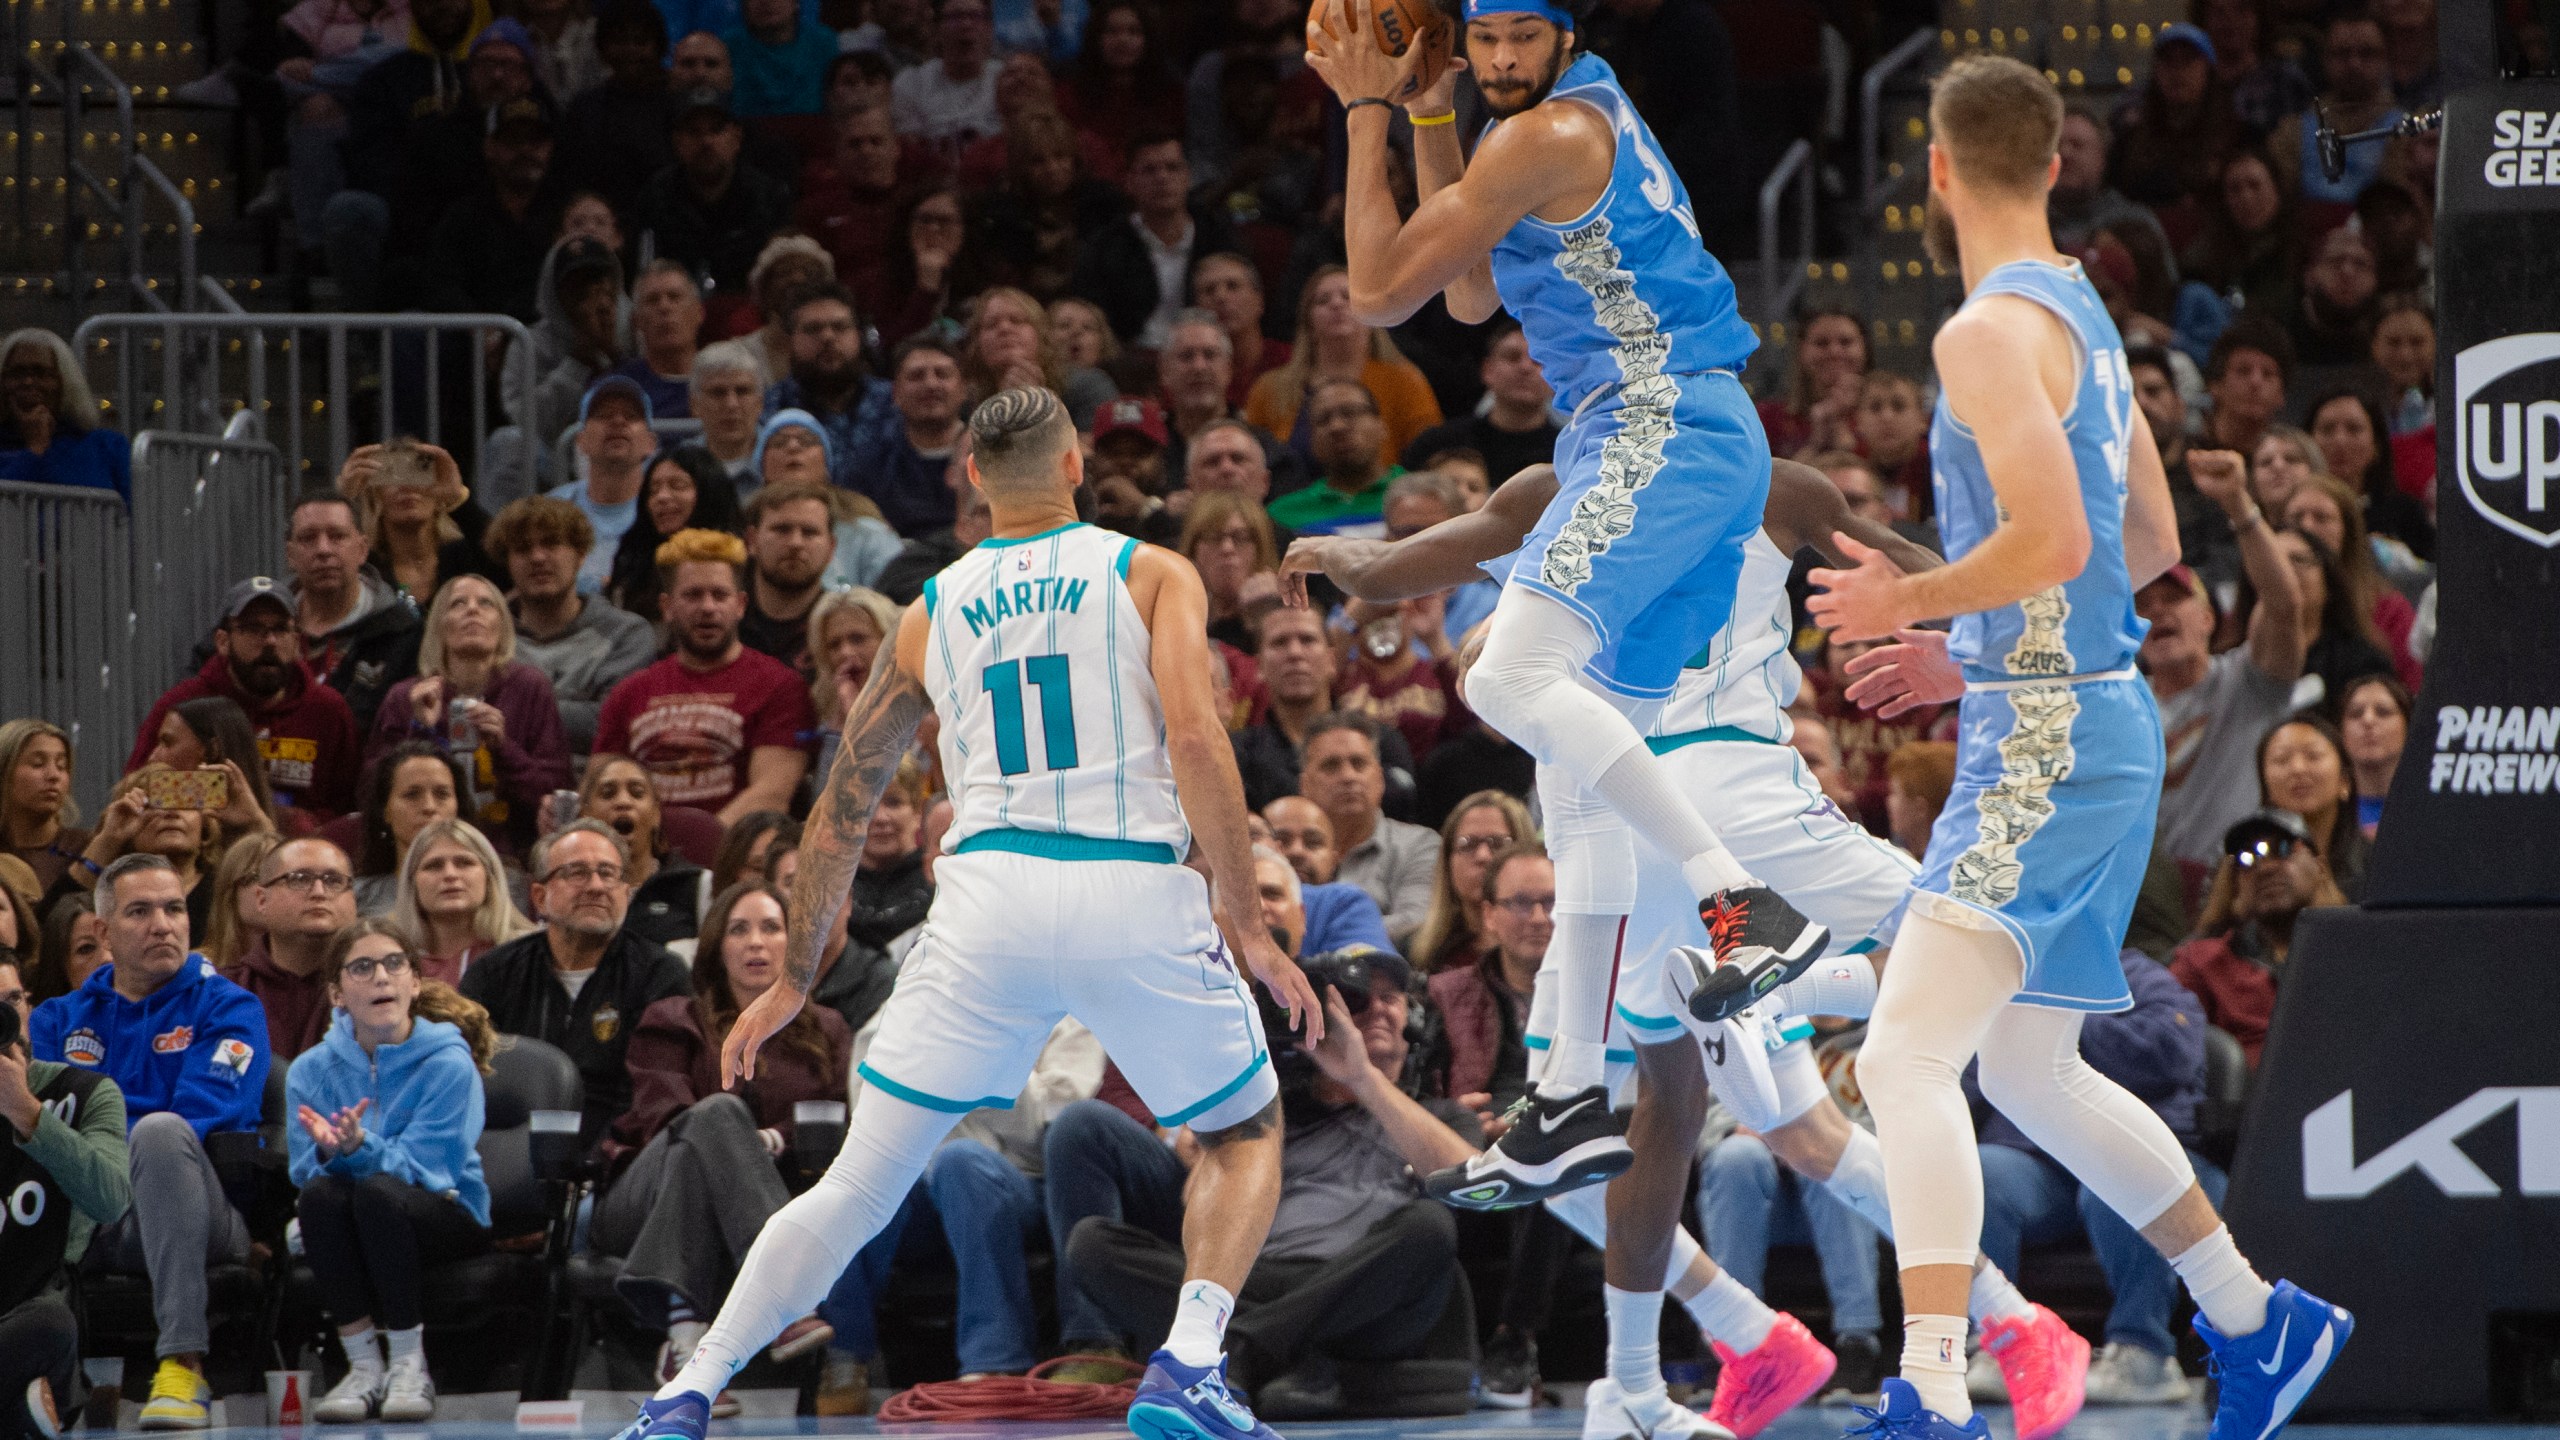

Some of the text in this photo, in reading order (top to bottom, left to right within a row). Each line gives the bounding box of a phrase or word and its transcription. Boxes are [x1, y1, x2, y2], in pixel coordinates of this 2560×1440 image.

[1620, 99, 1672, 212] 3
[252, 576, 274, 591] C
[961, 577, 1089, 638] MARTIN
[982, 653, 1080, 776] 11
[2436, 704, 2560, 752] PHAN
[2429, 752, 2560, 796] FIREW
